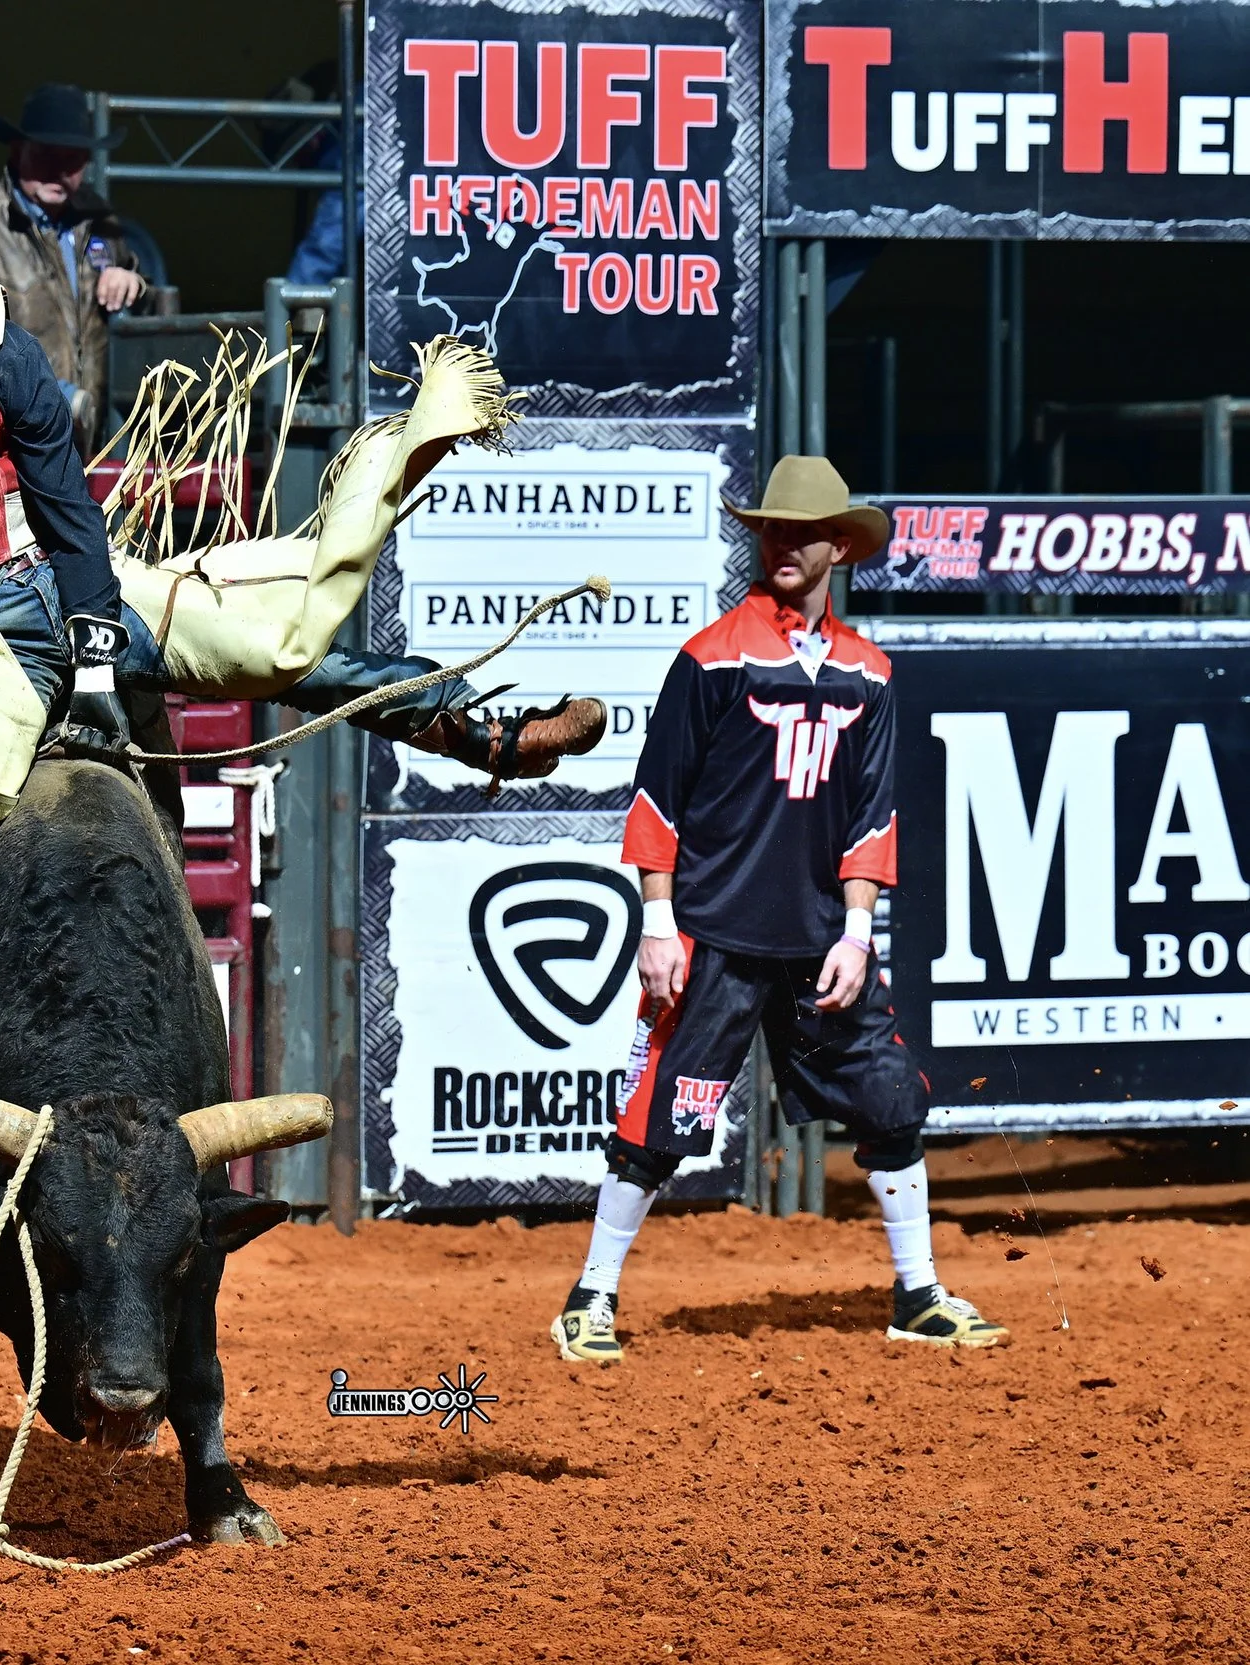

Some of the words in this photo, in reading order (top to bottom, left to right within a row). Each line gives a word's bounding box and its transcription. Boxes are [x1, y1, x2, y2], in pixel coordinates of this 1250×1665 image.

[404, 39, 727, 171] TUFF
[410, 173, 720, 241] HEDEMAN
[555, 252, 720, 316] TOUR
[427, 484, 692, 514] PANHANDLE
[894, 508, 989, 540] TUFF
[988, 513, 1207, 585] HOBBS,
[930, 560, 979, 577] TOUR
[427, 595, 691, 625] PANHANDLE
[973, 1004, 1181, 1036] WESTERN
